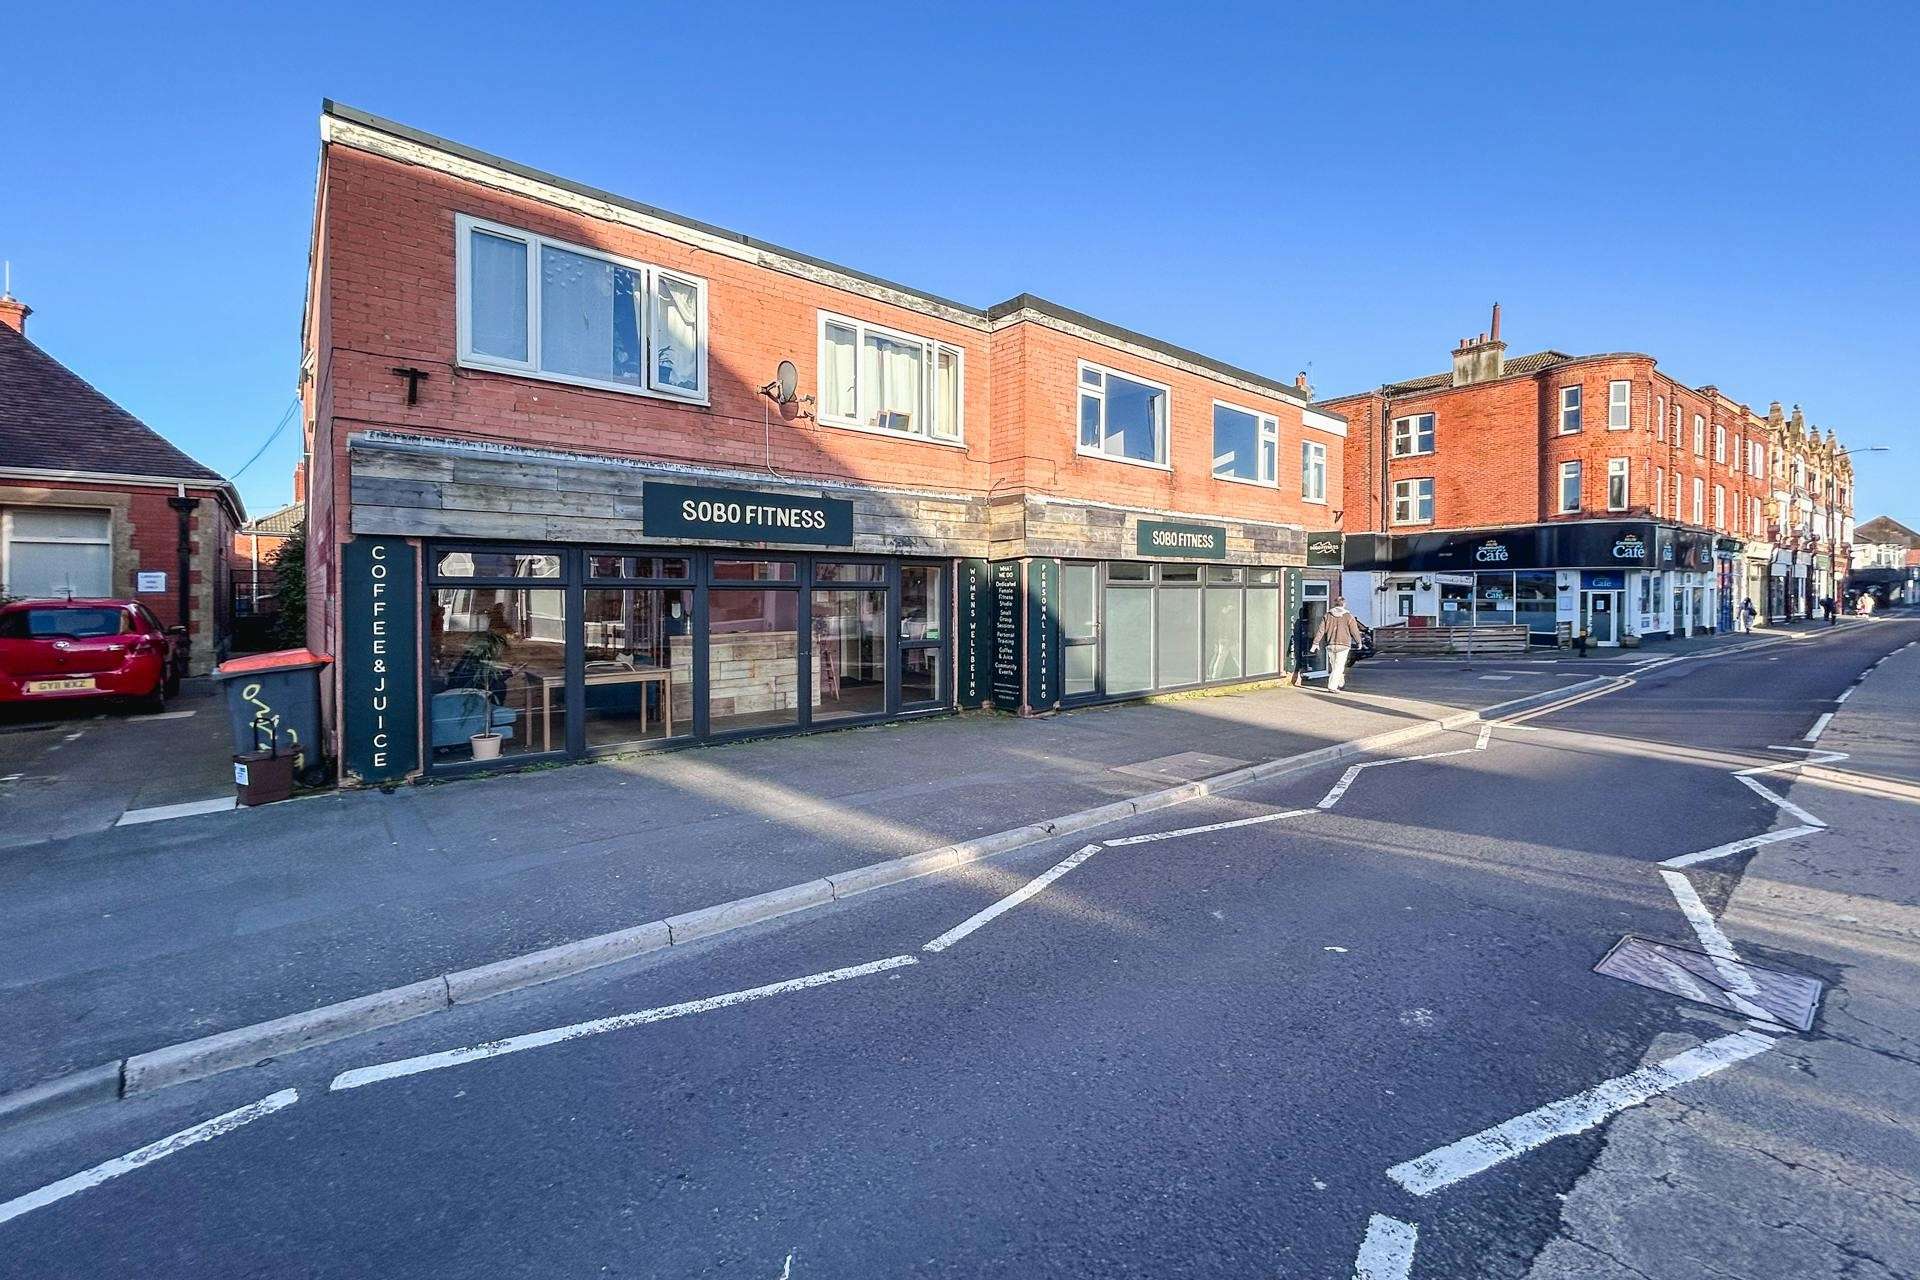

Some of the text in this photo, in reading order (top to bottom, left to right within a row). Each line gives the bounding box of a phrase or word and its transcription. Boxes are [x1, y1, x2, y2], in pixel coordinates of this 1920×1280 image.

[682, 500, 826, 530] SOBO FITNESS
[1152, 530, 1214, 549] SOBO FITNESS
[1475, 548, 1509, 561] Café
[1613, 544, 1645, 558] Café
